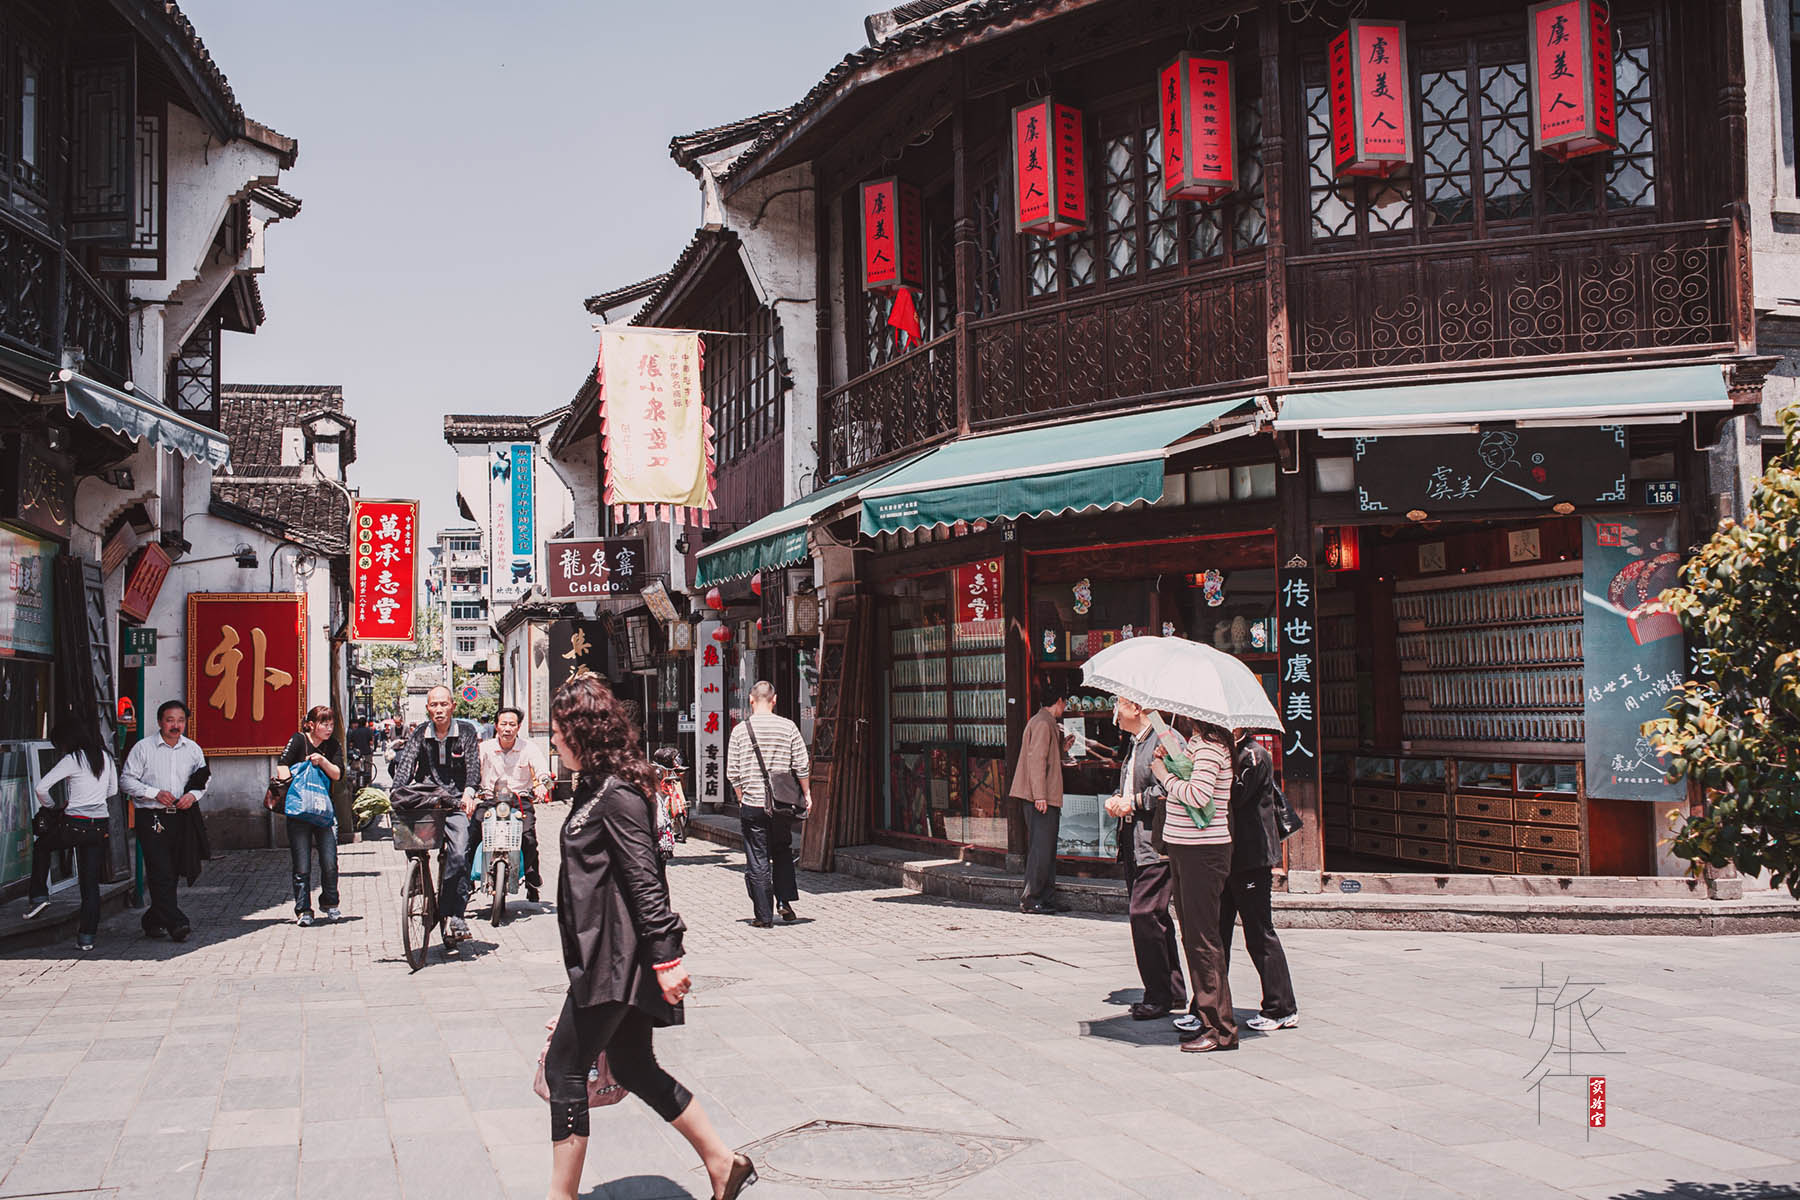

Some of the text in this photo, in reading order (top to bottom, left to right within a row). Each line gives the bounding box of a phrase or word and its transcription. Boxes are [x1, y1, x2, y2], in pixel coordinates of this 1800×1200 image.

[1368, 37, 1398, 130] 虞美人
[1547, 16, 1576, 112] 虞美人
[1024, 116, 1044, 200] 虞美人
[1167, 77, 1181, 167] 虞美人
[872, 192, 890, 264] 虞美人
[1425, 465, 1555, 500] 虞美人
[1653, 491, 1674, 503] 156
[373, 513, 401, 625] 萬承志堂
[568, 580, 630, 593] Celado
[1283, 578, 1314, 758] 传世虞美人
[1588, 664, 1650, 703] 传世工艺
[1611, 753, 1667, 776] 虞美人
